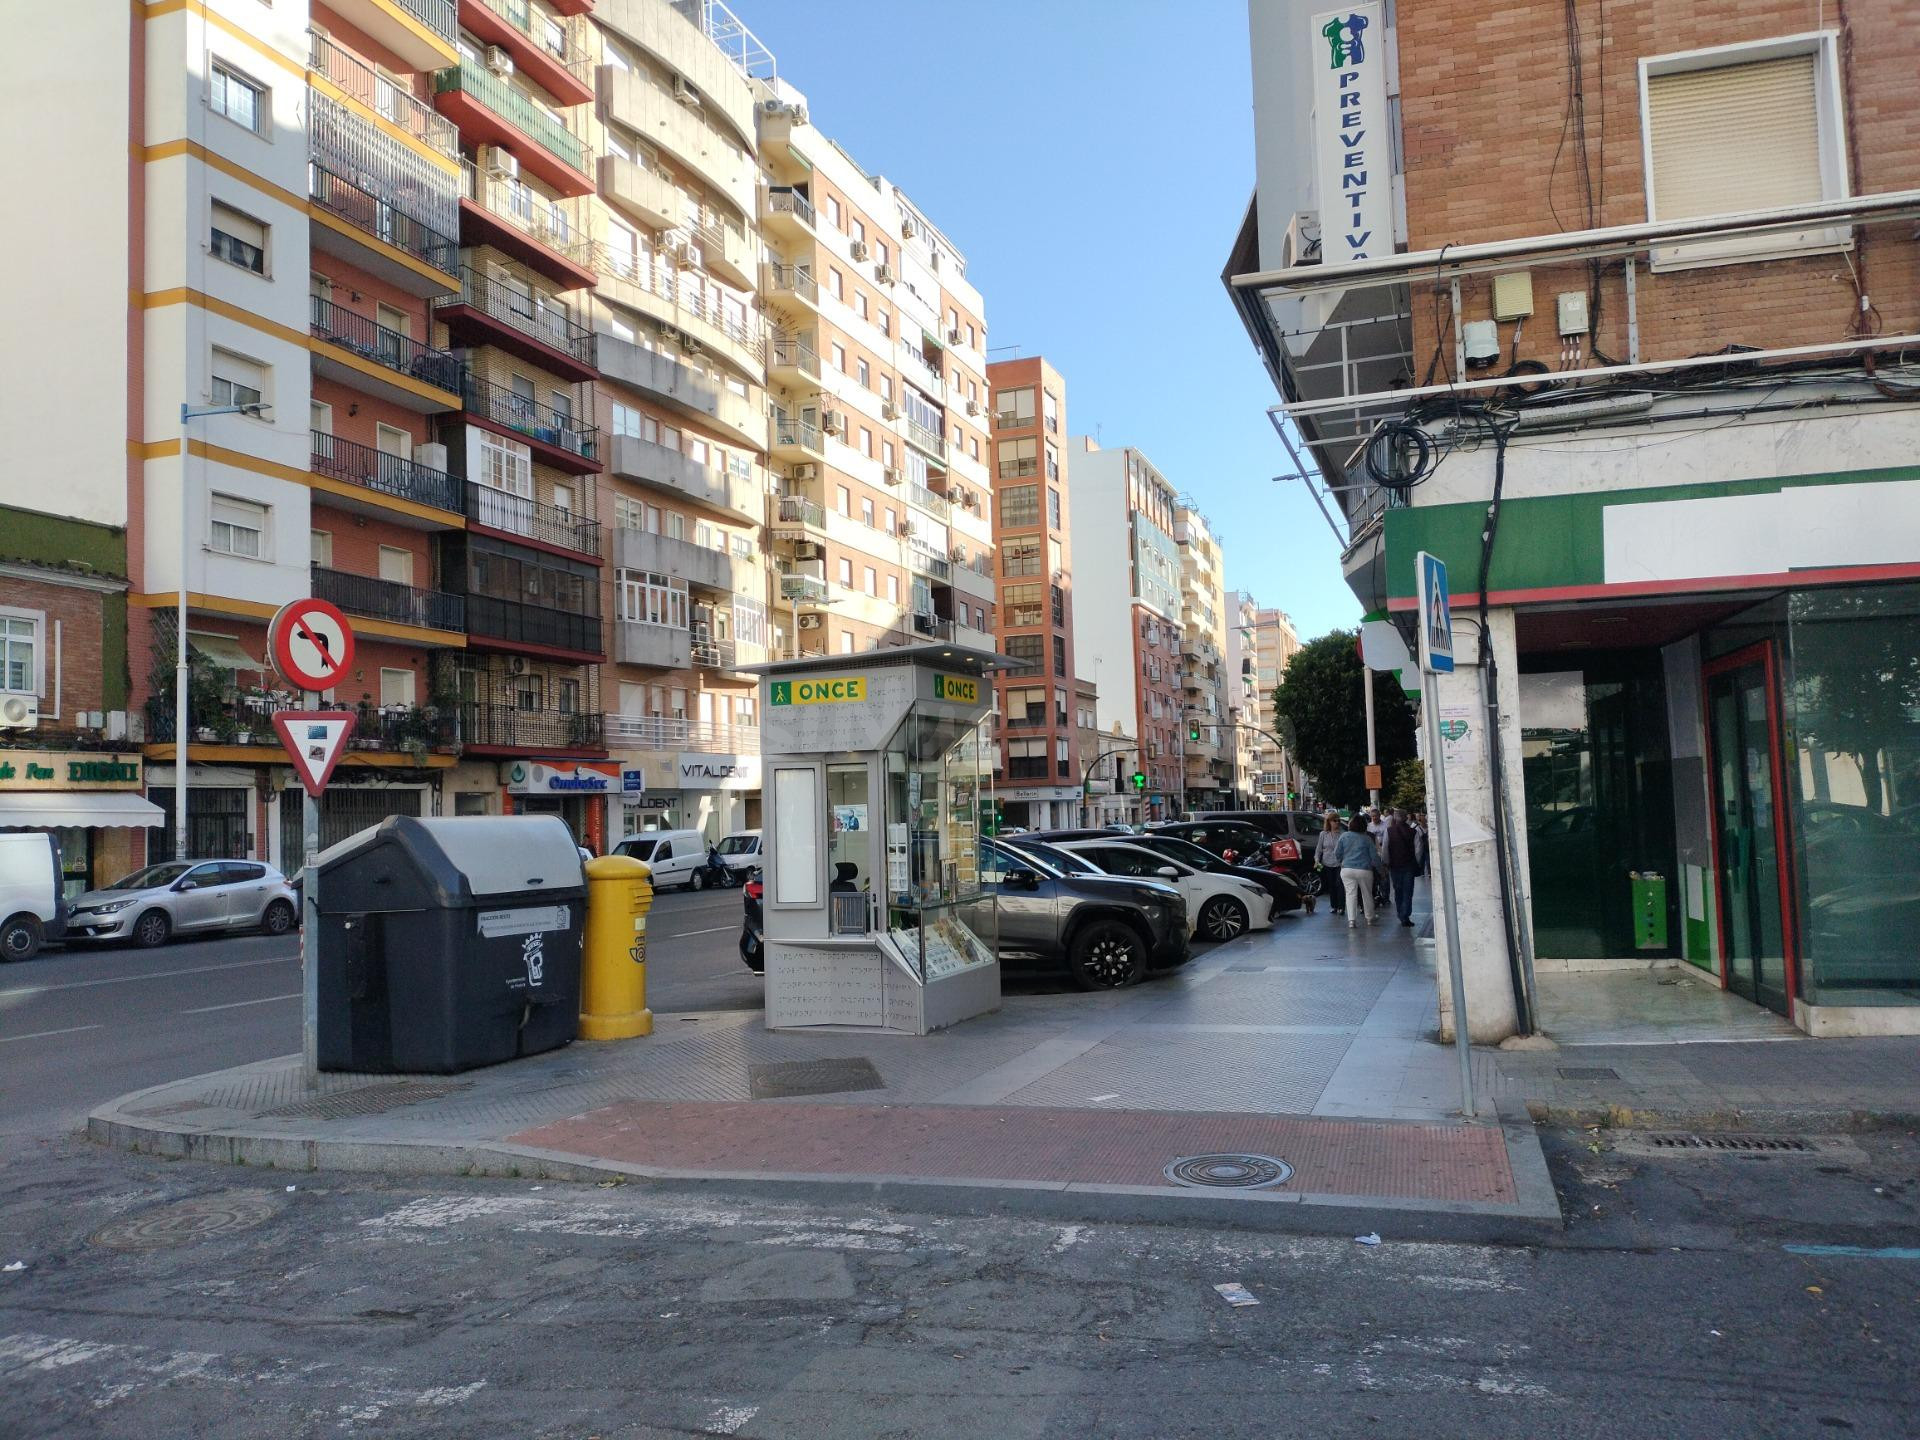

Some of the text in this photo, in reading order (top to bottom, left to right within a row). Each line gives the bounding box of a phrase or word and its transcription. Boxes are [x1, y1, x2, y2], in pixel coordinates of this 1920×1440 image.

[799, 680, 859, 700] ONCE
[947, 681, 975, 700] ONCE
[681, 764, 750, 778] VITALDENT
